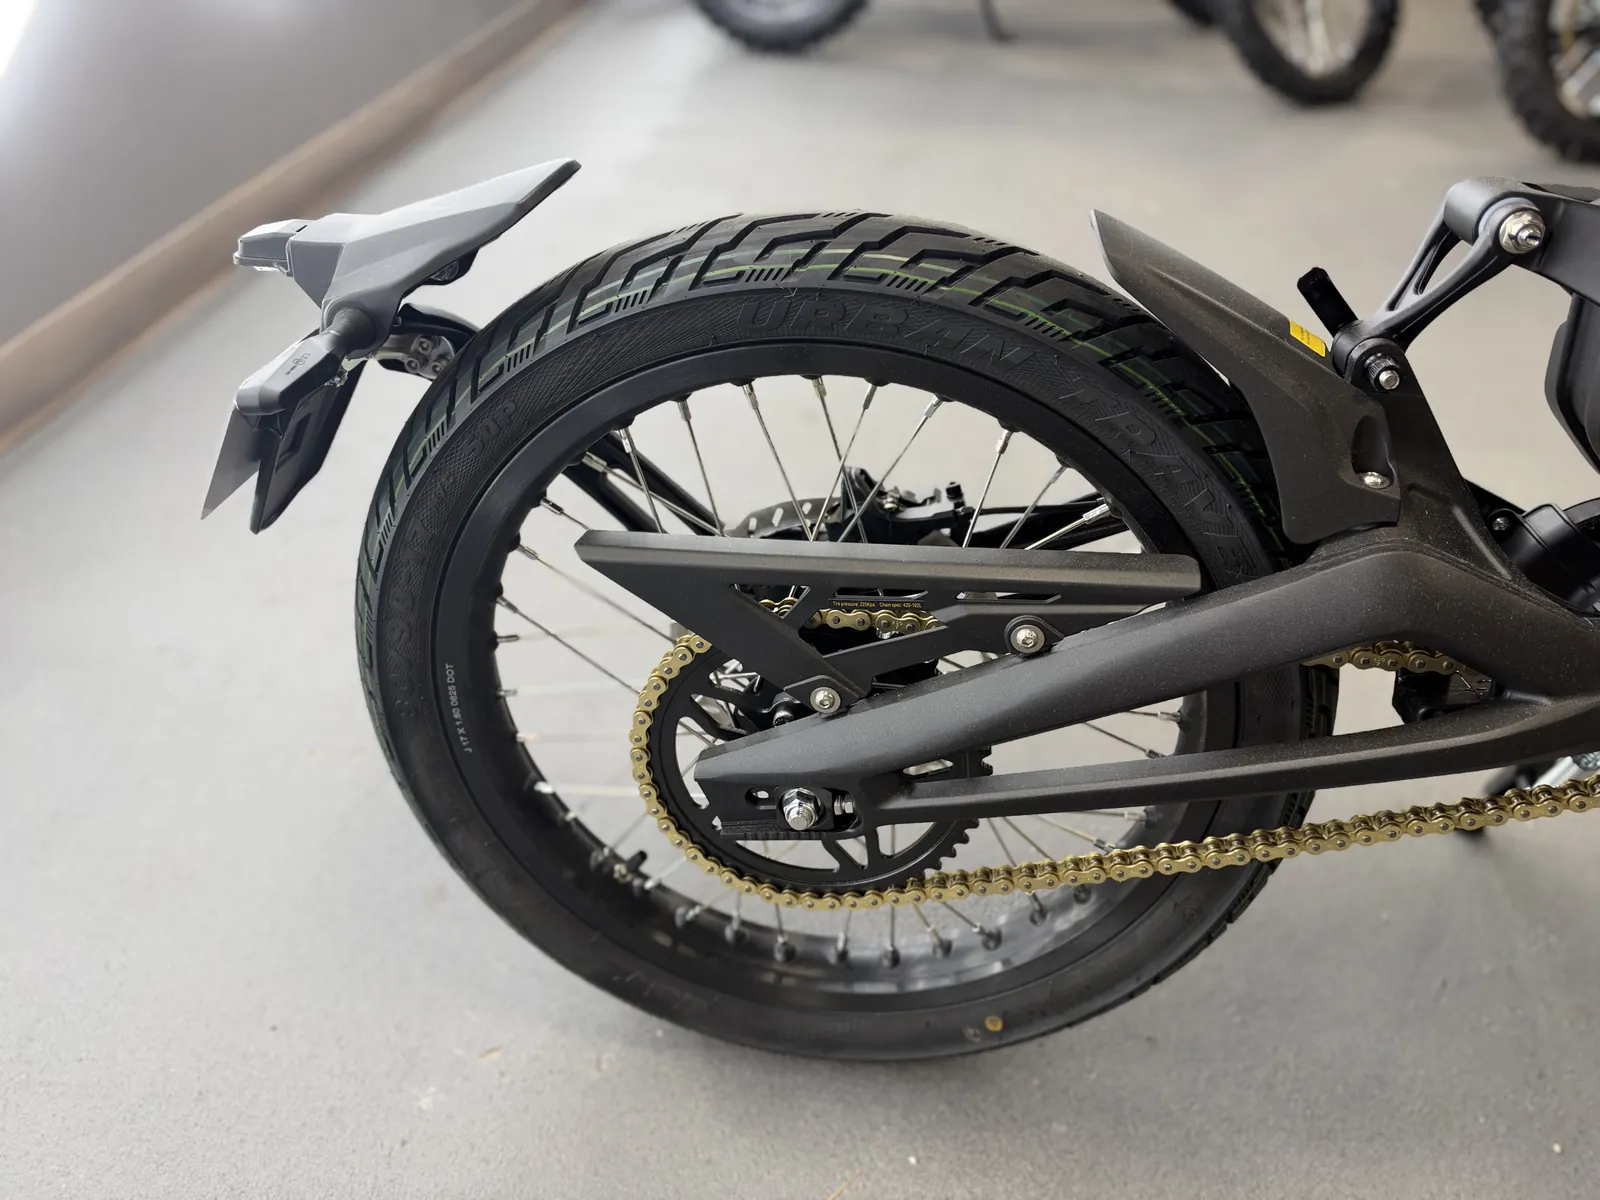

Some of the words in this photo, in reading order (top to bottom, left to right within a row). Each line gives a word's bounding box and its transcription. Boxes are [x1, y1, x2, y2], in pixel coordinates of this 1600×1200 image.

[737, 298, 1036, 375] URBAN
[445, 663, 455, 683] DOT
[448, 685, 458, 706] 0825
[452, 707, 462, 726] 1.60
[460, 735, 469, 746] 17
